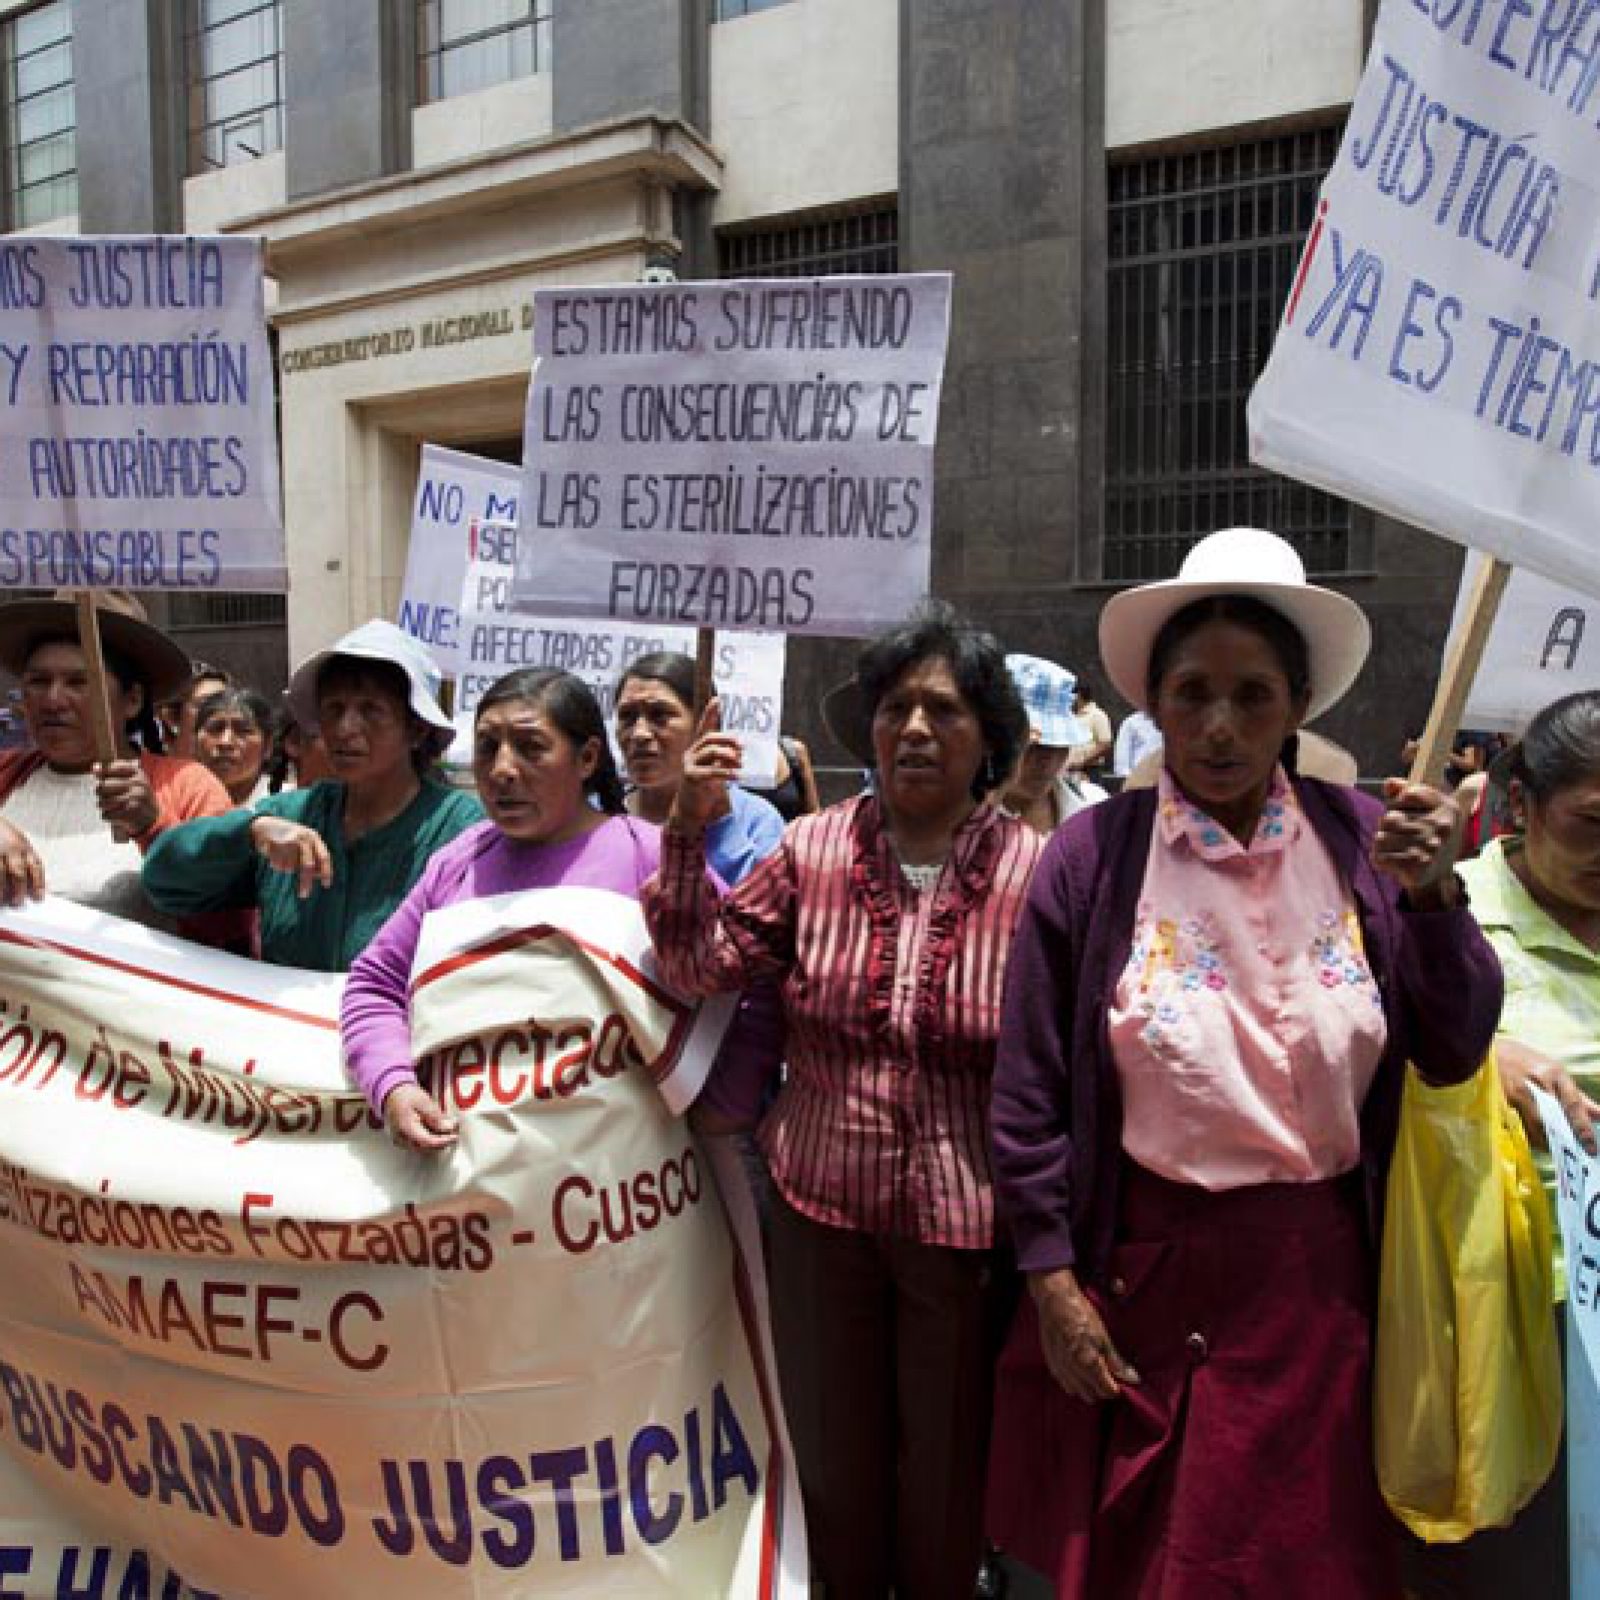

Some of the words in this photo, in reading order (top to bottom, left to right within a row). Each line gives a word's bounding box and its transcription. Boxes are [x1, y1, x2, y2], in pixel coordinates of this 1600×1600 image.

[551, 293, 698, 357] ESTAMOS
[1388, 278, 1463, 393] ES
[0, 344, 30, 407] Y
[542, 386, 604, 442] LAS
[877, 383, 928, 441] DE
[419, 479, 463, 526] NO
[536, 471, 600, 529] LAS
[607, 560, 815, 627] FORZADAS
[469, 623, 614, 672] AFECTADAS
[1540, 606, 1585, 669] A
[75, 1023, 150, 1110] de
[240, 1191, 494, 1272] Forzadas
[552, 1147, 702, 1255] Cusco
[68, 1259, 391, 1373] AMAEF-C
[0, 1362, 347, 1548] BUSCANDO
[371, 1379, 761, 1570] JUSTICIA
